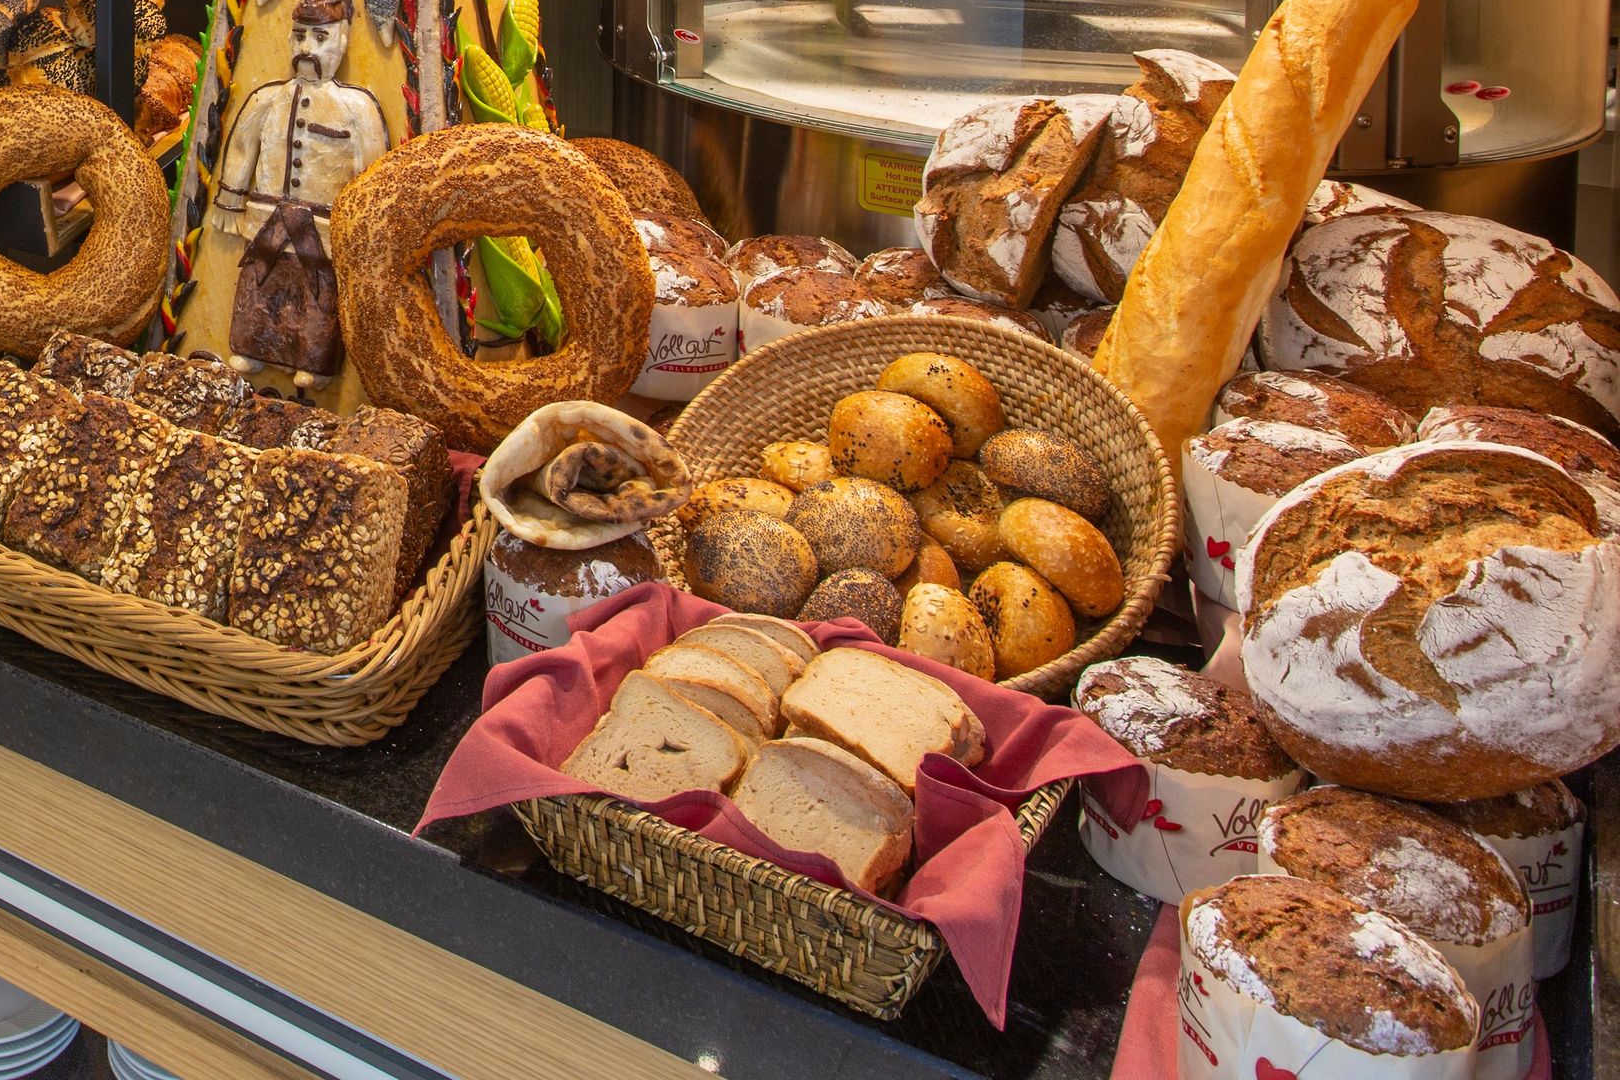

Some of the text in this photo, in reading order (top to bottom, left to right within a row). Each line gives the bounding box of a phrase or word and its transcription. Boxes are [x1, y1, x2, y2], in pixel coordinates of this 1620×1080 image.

[885, 171, 901, 181] Hot
[876, 183, 923, 197] ATTENTIO
[870, 192, 903, 205] Surface
